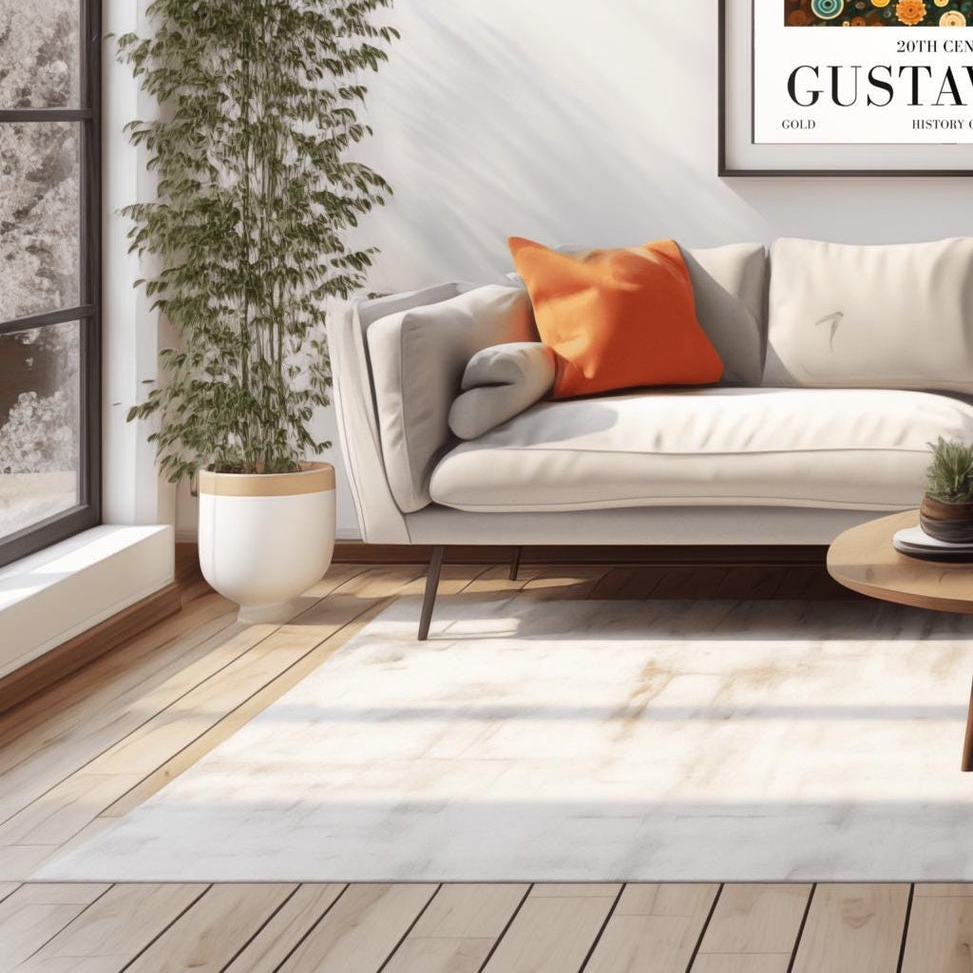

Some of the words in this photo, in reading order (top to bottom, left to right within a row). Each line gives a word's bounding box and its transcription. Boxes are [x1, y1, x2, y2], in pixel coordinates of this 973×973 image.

[896, 40, 937, 53] 20TH
[781, 119, 816, 129] GOLD
[912, 119, 965, 129] HISTORY
